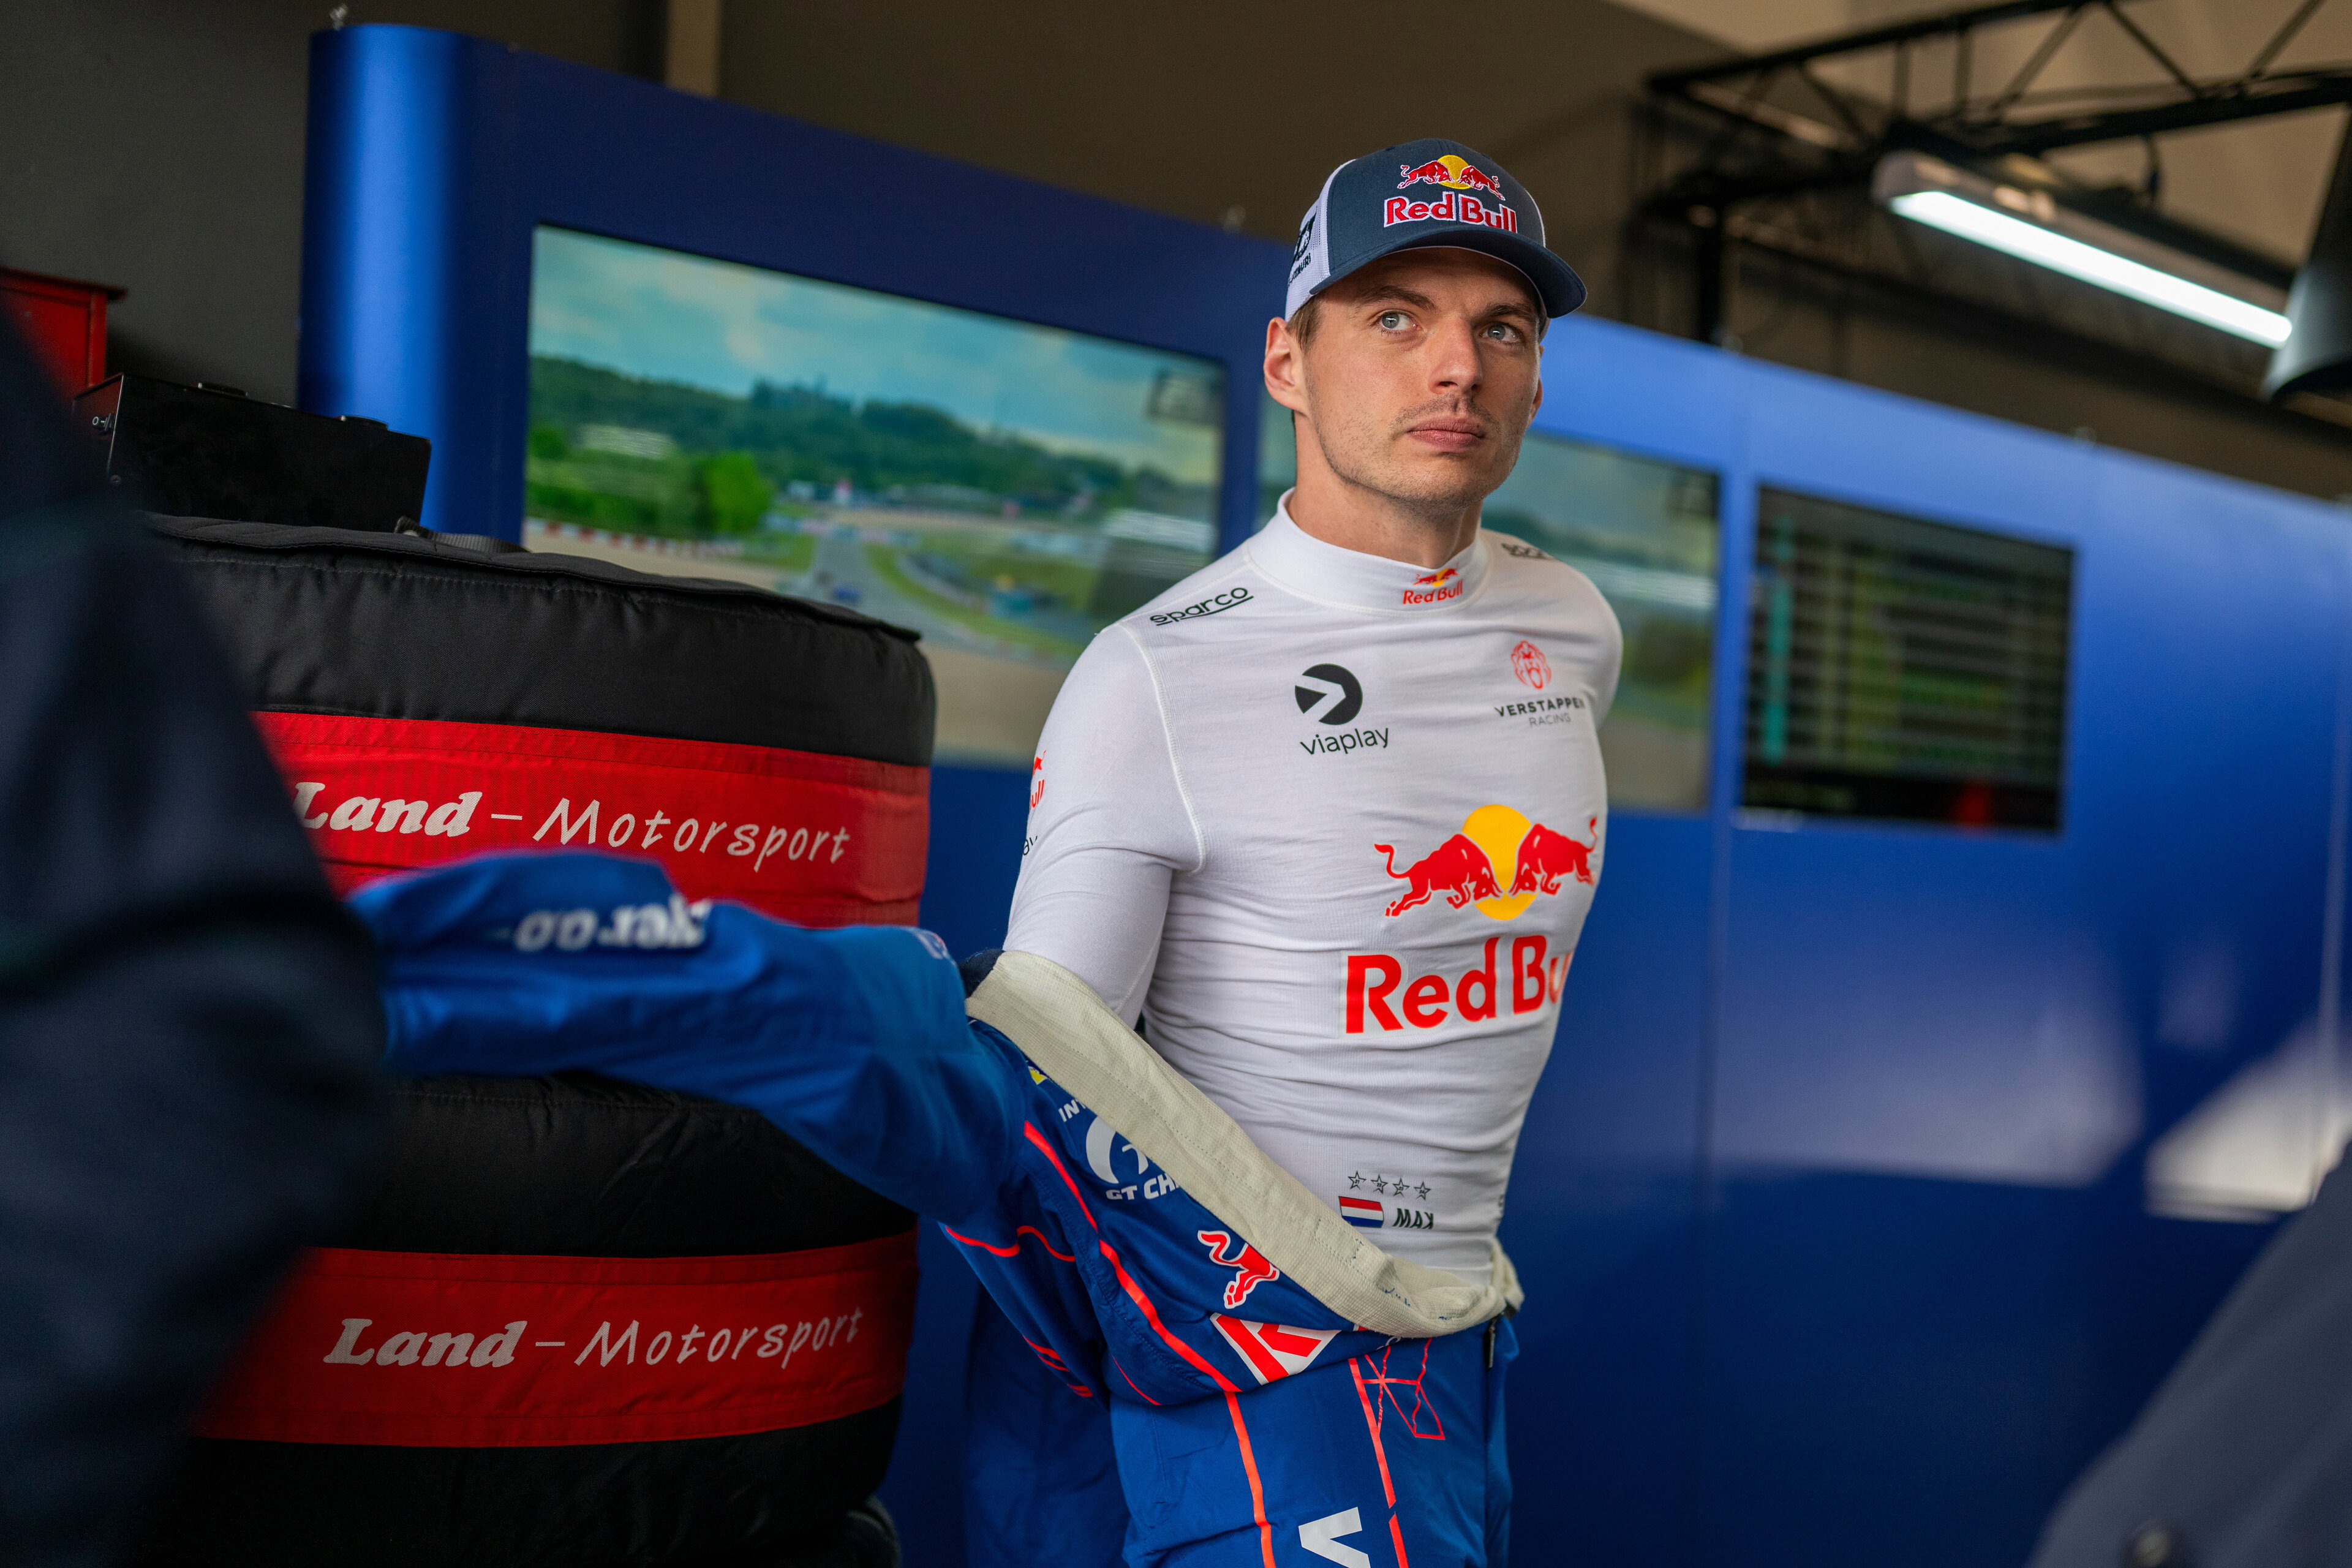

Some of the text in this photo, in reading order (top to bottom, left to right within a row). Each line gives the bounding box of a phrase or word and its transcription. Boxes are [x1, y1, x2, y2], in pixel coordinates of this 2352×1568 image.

[1384, 192, 1518, 233] Red Bull
[1150, 587, 1250, 624] sparco
[1402, 579, 1463, 605] Red Bull
[1529, 713, 1571, 727] RACING
[1300, 728, 1389, 755] viaplay
[292, 782, 483, 837] Land
[532, 798, 850, 873] Motorsport
[1346, 935, 1574, 1034] Red Bu
[1106, 1173, 1180, 1200] GT CH
[323, 1318, 527, 1368] Land
[574, 1307, 863, 1369] Motorsport
